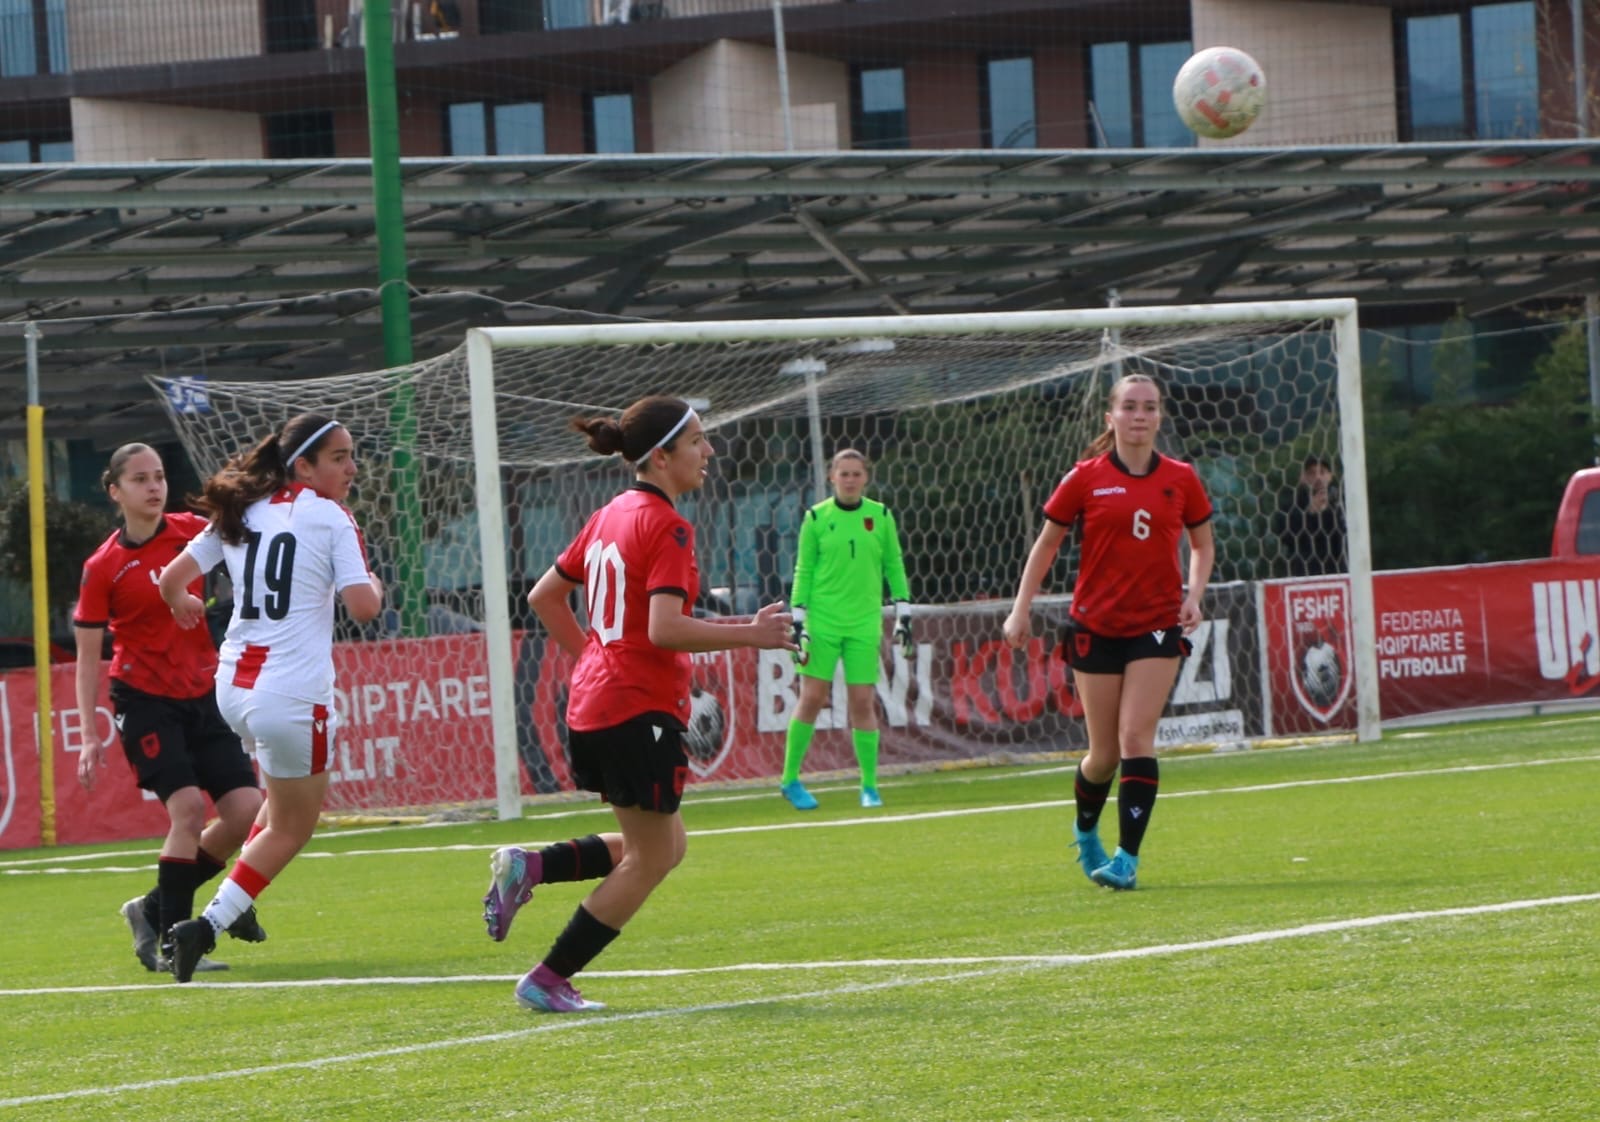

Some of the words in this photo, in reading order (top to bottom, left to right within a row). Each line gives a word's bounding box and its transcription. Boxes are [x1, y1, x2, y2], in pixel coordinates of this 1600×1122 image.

[1132, 508, 1152, 541] 6
[847, 538, 856, 560] 1
[240, 531, 297, 621] 19
[583, 538, 626, 647] 10
[1293, 595, 1341, 621] FSHF
[1381, 608, 1463, 632] FEDERATA
[1375, 632, 1451, 656] HQIPTARE
[1454, 631, 1466, 651] E
[1532, 578, 1600, 680] UN
[1380, 654, 1467, 679] FUTBOLLIT
[333, 675, 491, 729] QIPTARE
